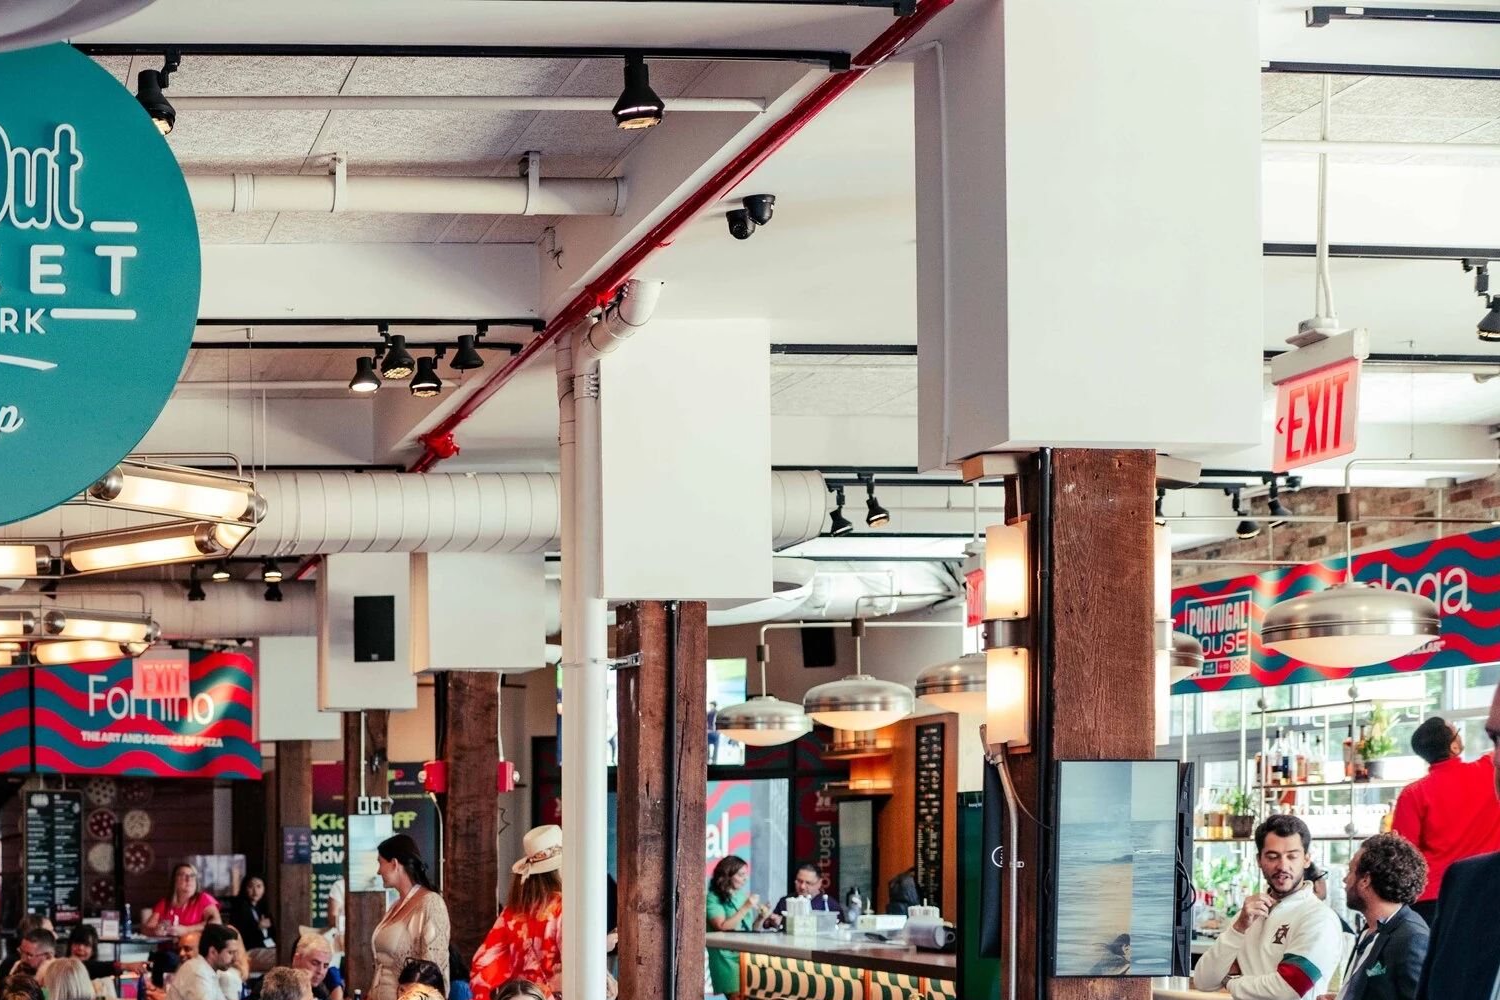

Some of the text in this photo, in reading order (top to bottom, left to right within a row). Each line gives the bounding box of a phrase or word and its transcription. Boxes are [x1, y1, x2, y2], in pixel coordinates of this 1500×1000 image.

[1285, 373, 1351, 462] EXIT
[1188, 600, 1248, 636] PORTUGAL
[1198, 631, 1248, 656] OUSE
[142, 664, 182, 696] EXIT
[80, 730, 224, 748] THE ART AND SCIENCE OF PIZZA
[817, 821, 836, 892] ortugal
